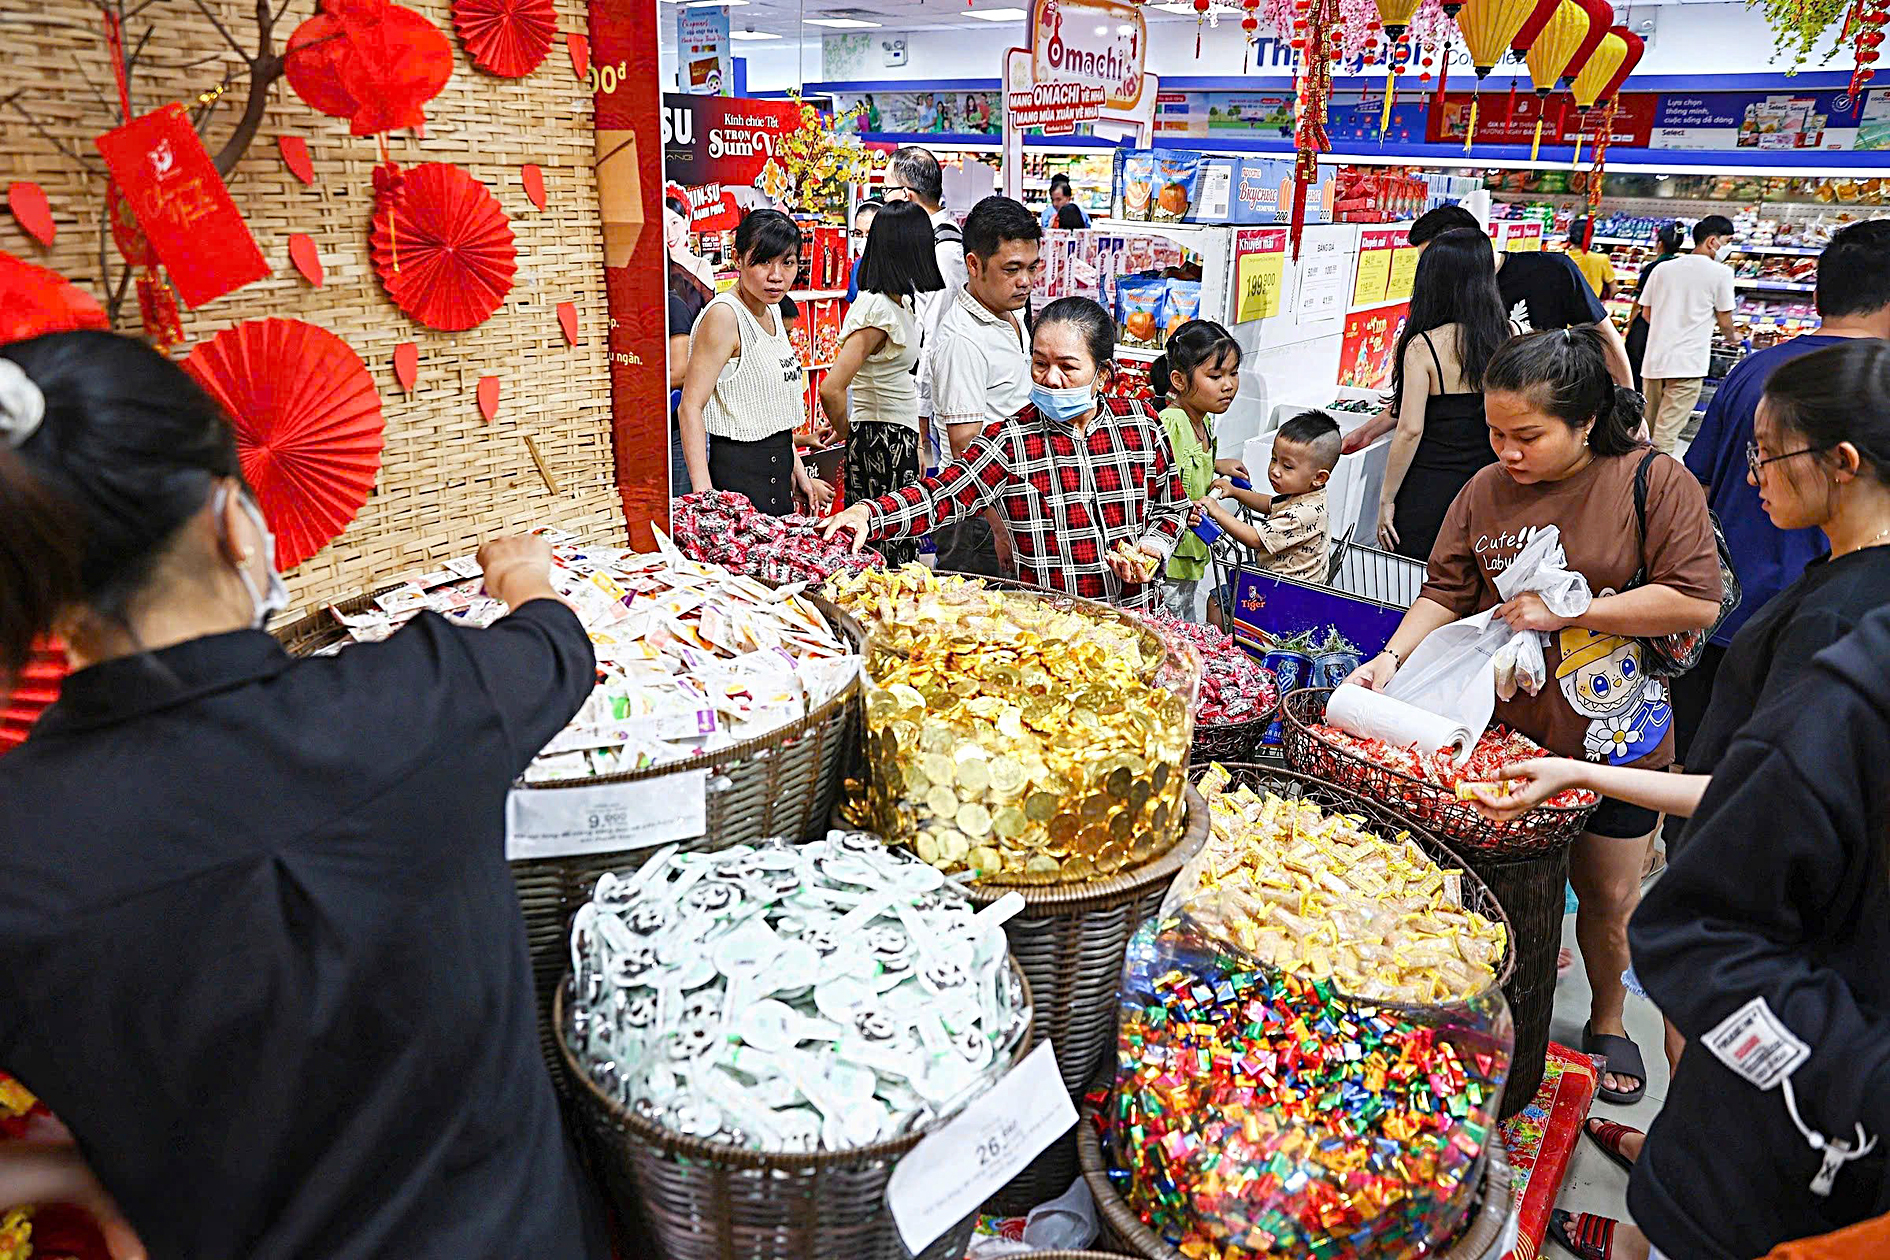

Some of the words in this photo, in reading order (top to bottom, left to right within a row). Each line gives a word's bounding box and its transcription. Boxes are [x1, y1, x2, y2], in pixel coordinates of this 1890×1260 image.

[1048, 35, 1124, 81] Omachi
[1010, 94, 1033, 108] MANG
[1683, 98, 1703, 107] chọn
[1016, 111, 1039, 124] MANG
[1665, 107, 1688, 116] thông
[724, 113, 744, 126] Kính
[745, 113, 764, 127] chúc
[764, 114, 779, 128] Tết
[1683, 116, 1702, 125] sống
[724, 129, 751, 143] TRỌN
[708, 129, 754, 159] Sum
[1273, 211, 1288, 221] 200
[1319, 210, 1330, 220] 200
[1239, 236, 1263, 252] Khuyến
[616, 351, 643, 366] ngân.
[1483, 553, 1518, 571] Labu
[1241, 599, 1266, 612] Tiger
